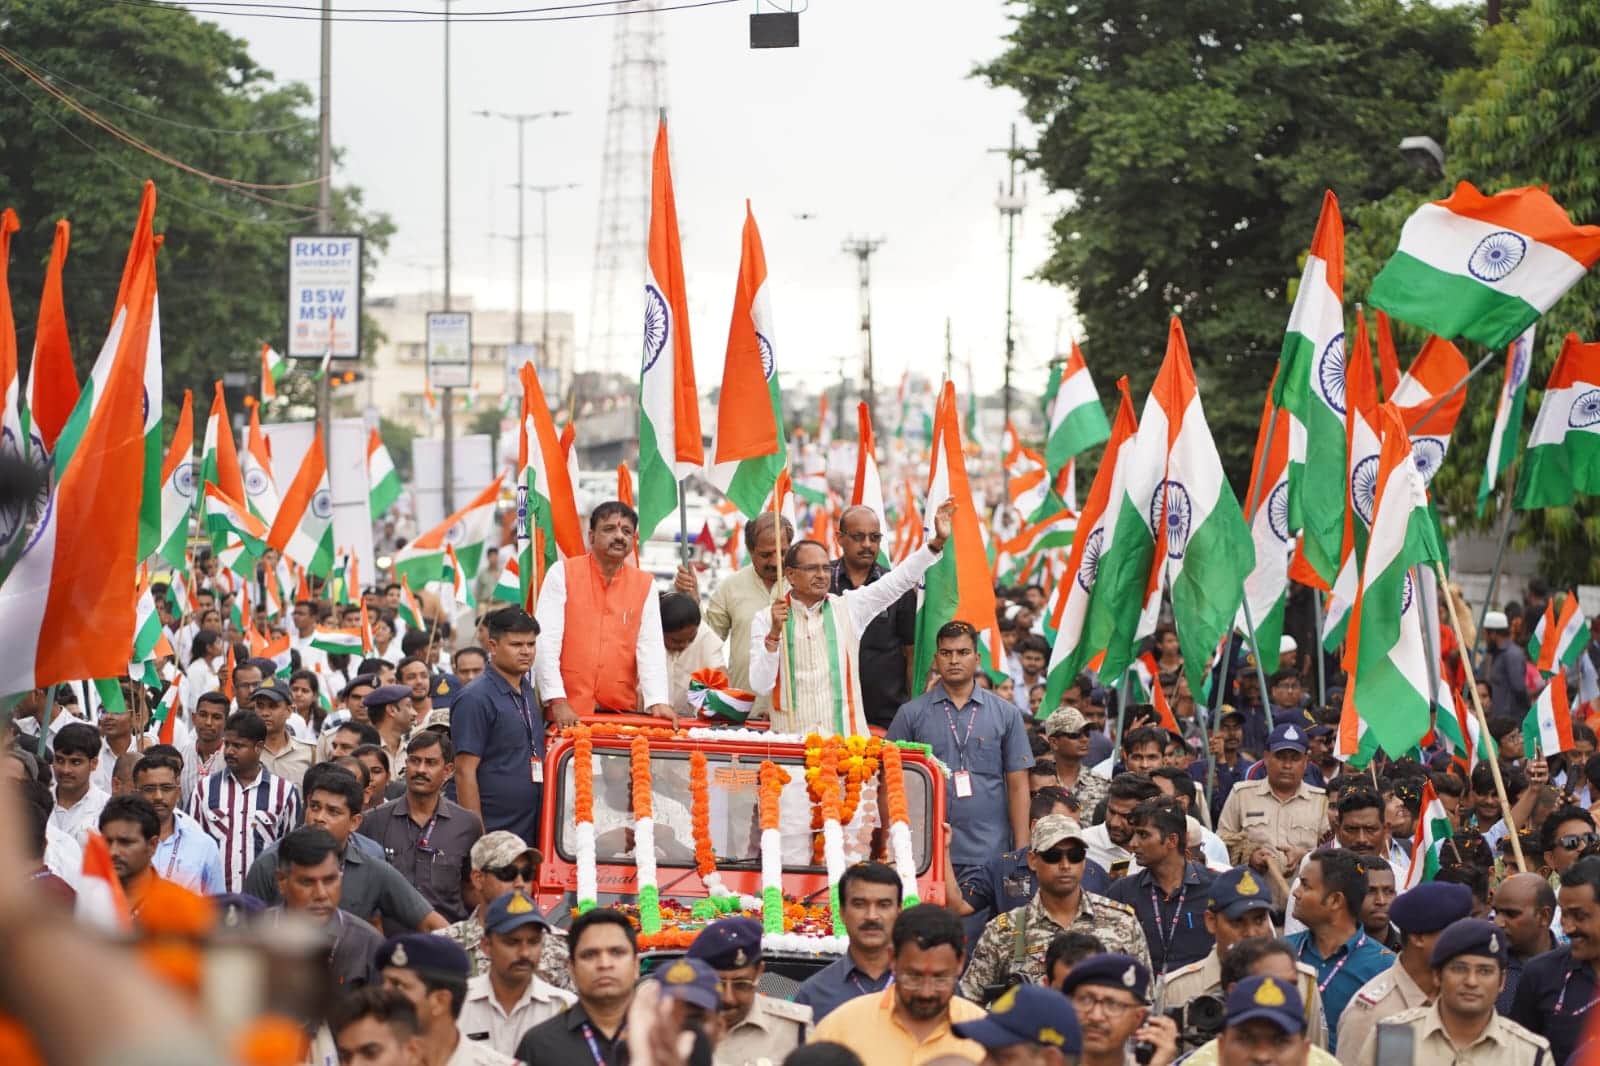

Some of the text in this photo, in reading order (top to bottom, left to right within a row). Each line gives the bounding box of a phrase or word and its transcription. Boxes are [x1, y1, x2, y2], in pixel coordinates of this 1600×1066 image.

[296, 243, 352, 256] RKDF
[301, 289, 344, 303] BSW
[300, 306, 346, 320] MSW
